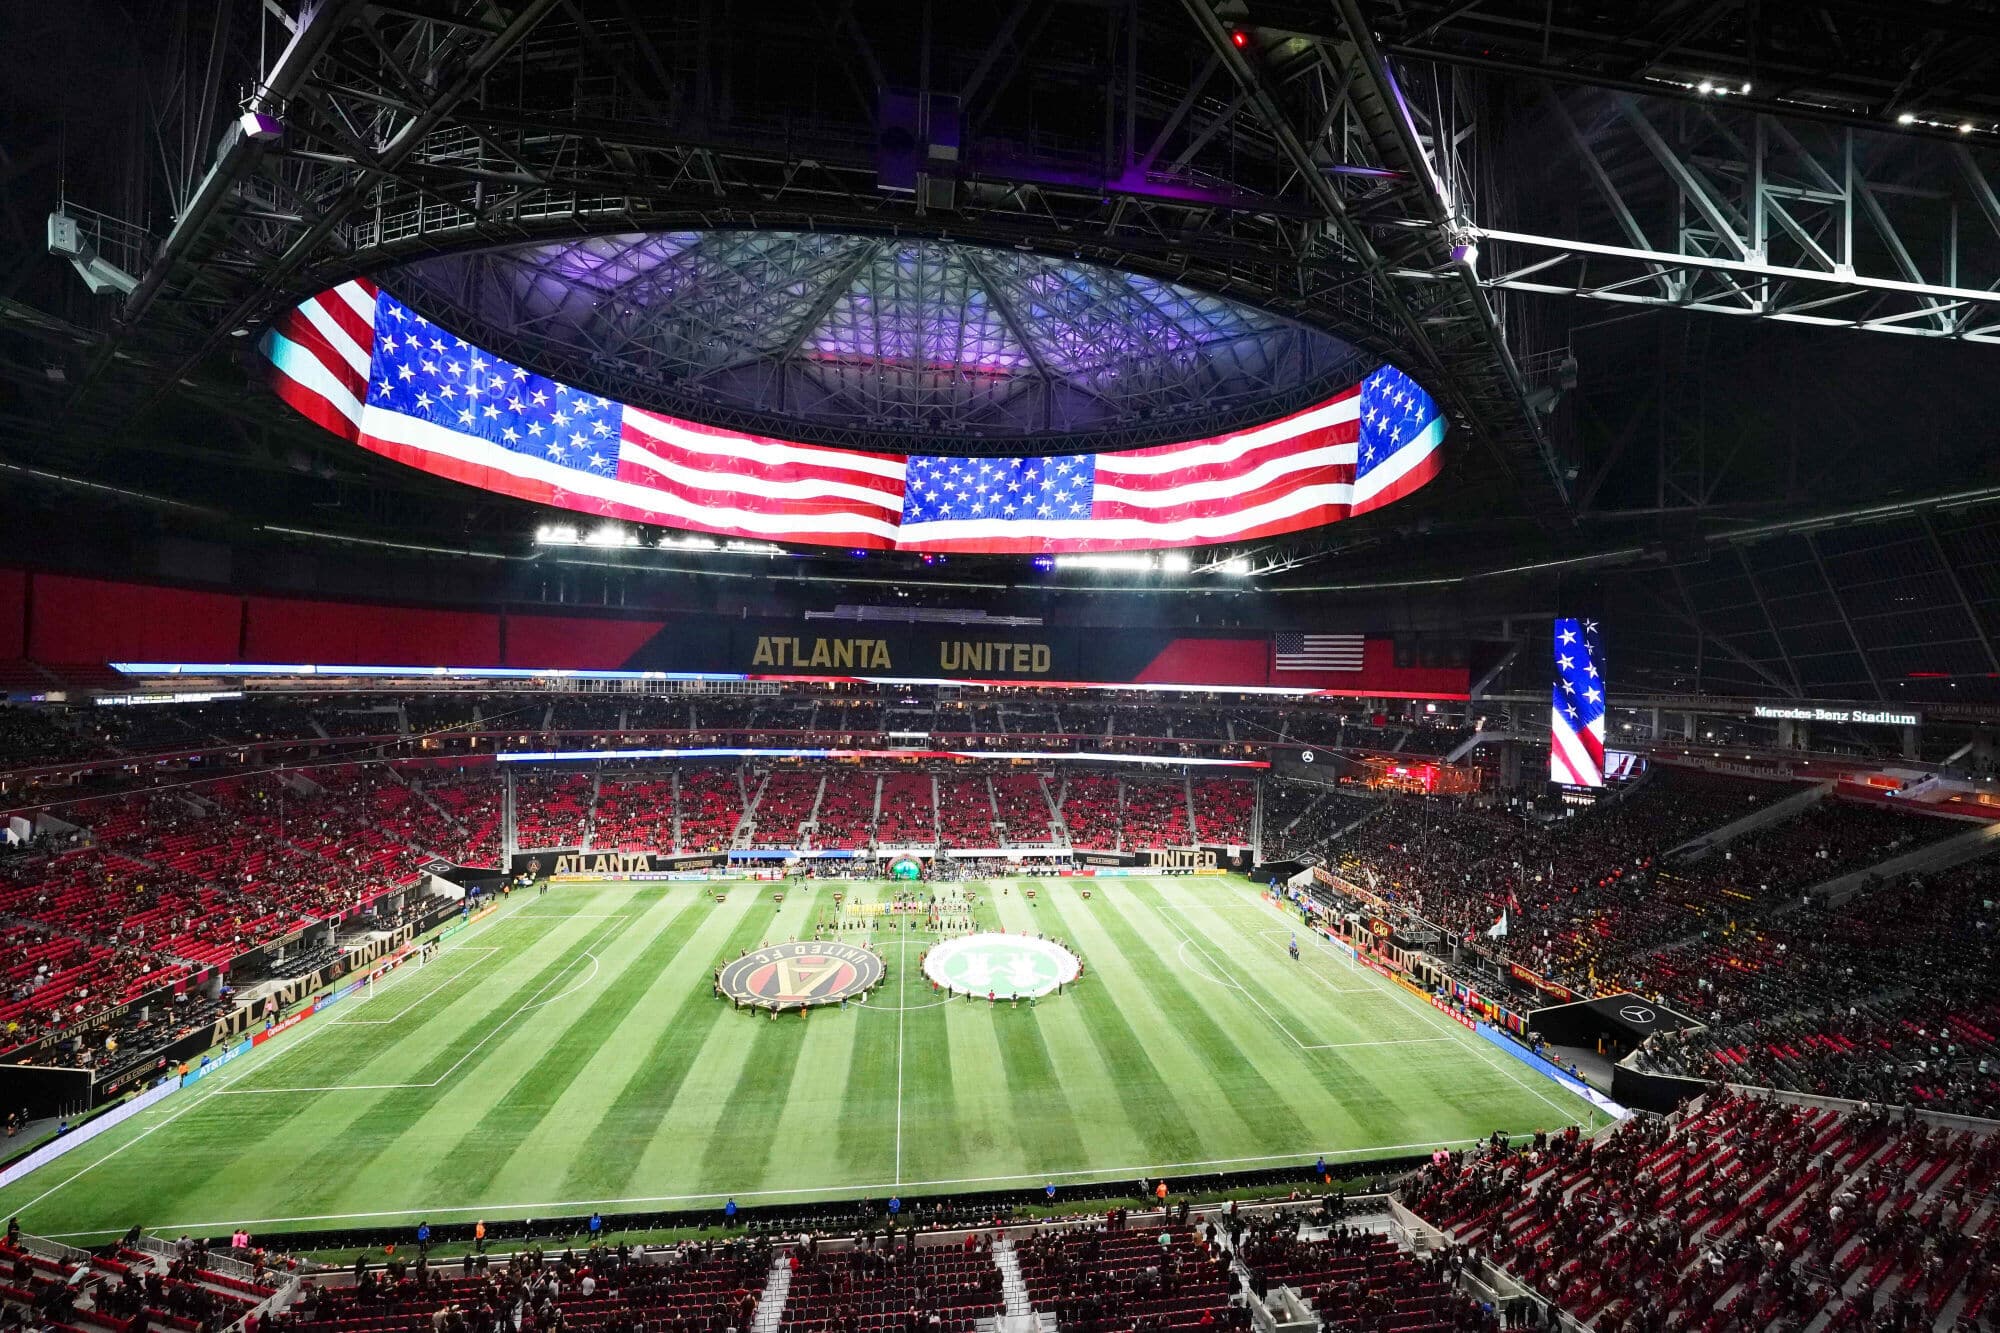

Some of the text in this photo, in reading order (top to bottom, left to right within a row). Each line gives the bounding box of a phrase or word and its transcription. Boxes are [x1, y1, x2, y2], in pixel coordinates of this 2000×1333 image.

[752, 636, 892, 669] ATLANTA
[941, 641, 1051, 673] UNITED
[1754, 706, 1917, 725] Mercedes-Benz Stadium
[553, 854, 650, 873] ATLANTA
[1151, 851, 1217, 867] UNITED
[212, 967, 323, 1047] ATLANTA
[40, 1004, 130, 1050] ATLANTA UNITED
[267, 1021, 285, 1037] Captain
[198, 1057, 223, 1078] AT&T
